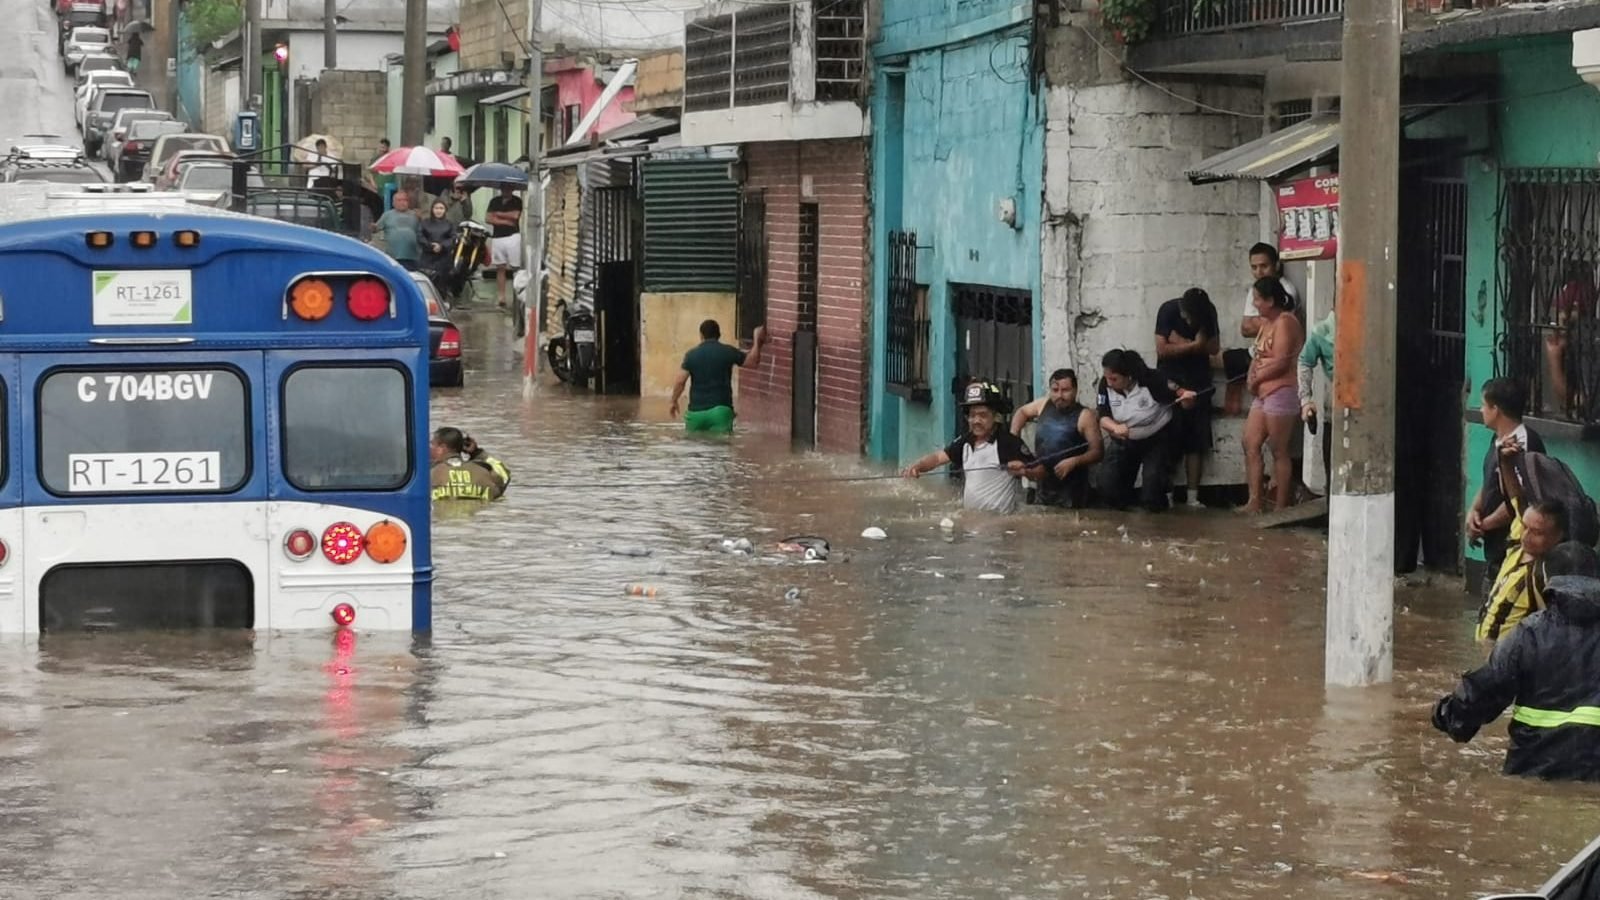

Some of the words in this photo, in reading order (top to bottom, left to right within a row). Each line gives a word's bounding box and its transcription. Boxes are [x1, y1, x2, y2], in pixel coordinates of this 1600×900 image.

[117, 286, 183, 300] RT-1261
[77, 376, 97, 402] C
[104, 374, 213, 401] 704BGV
[72, 457, 216, 485] RT-1261
